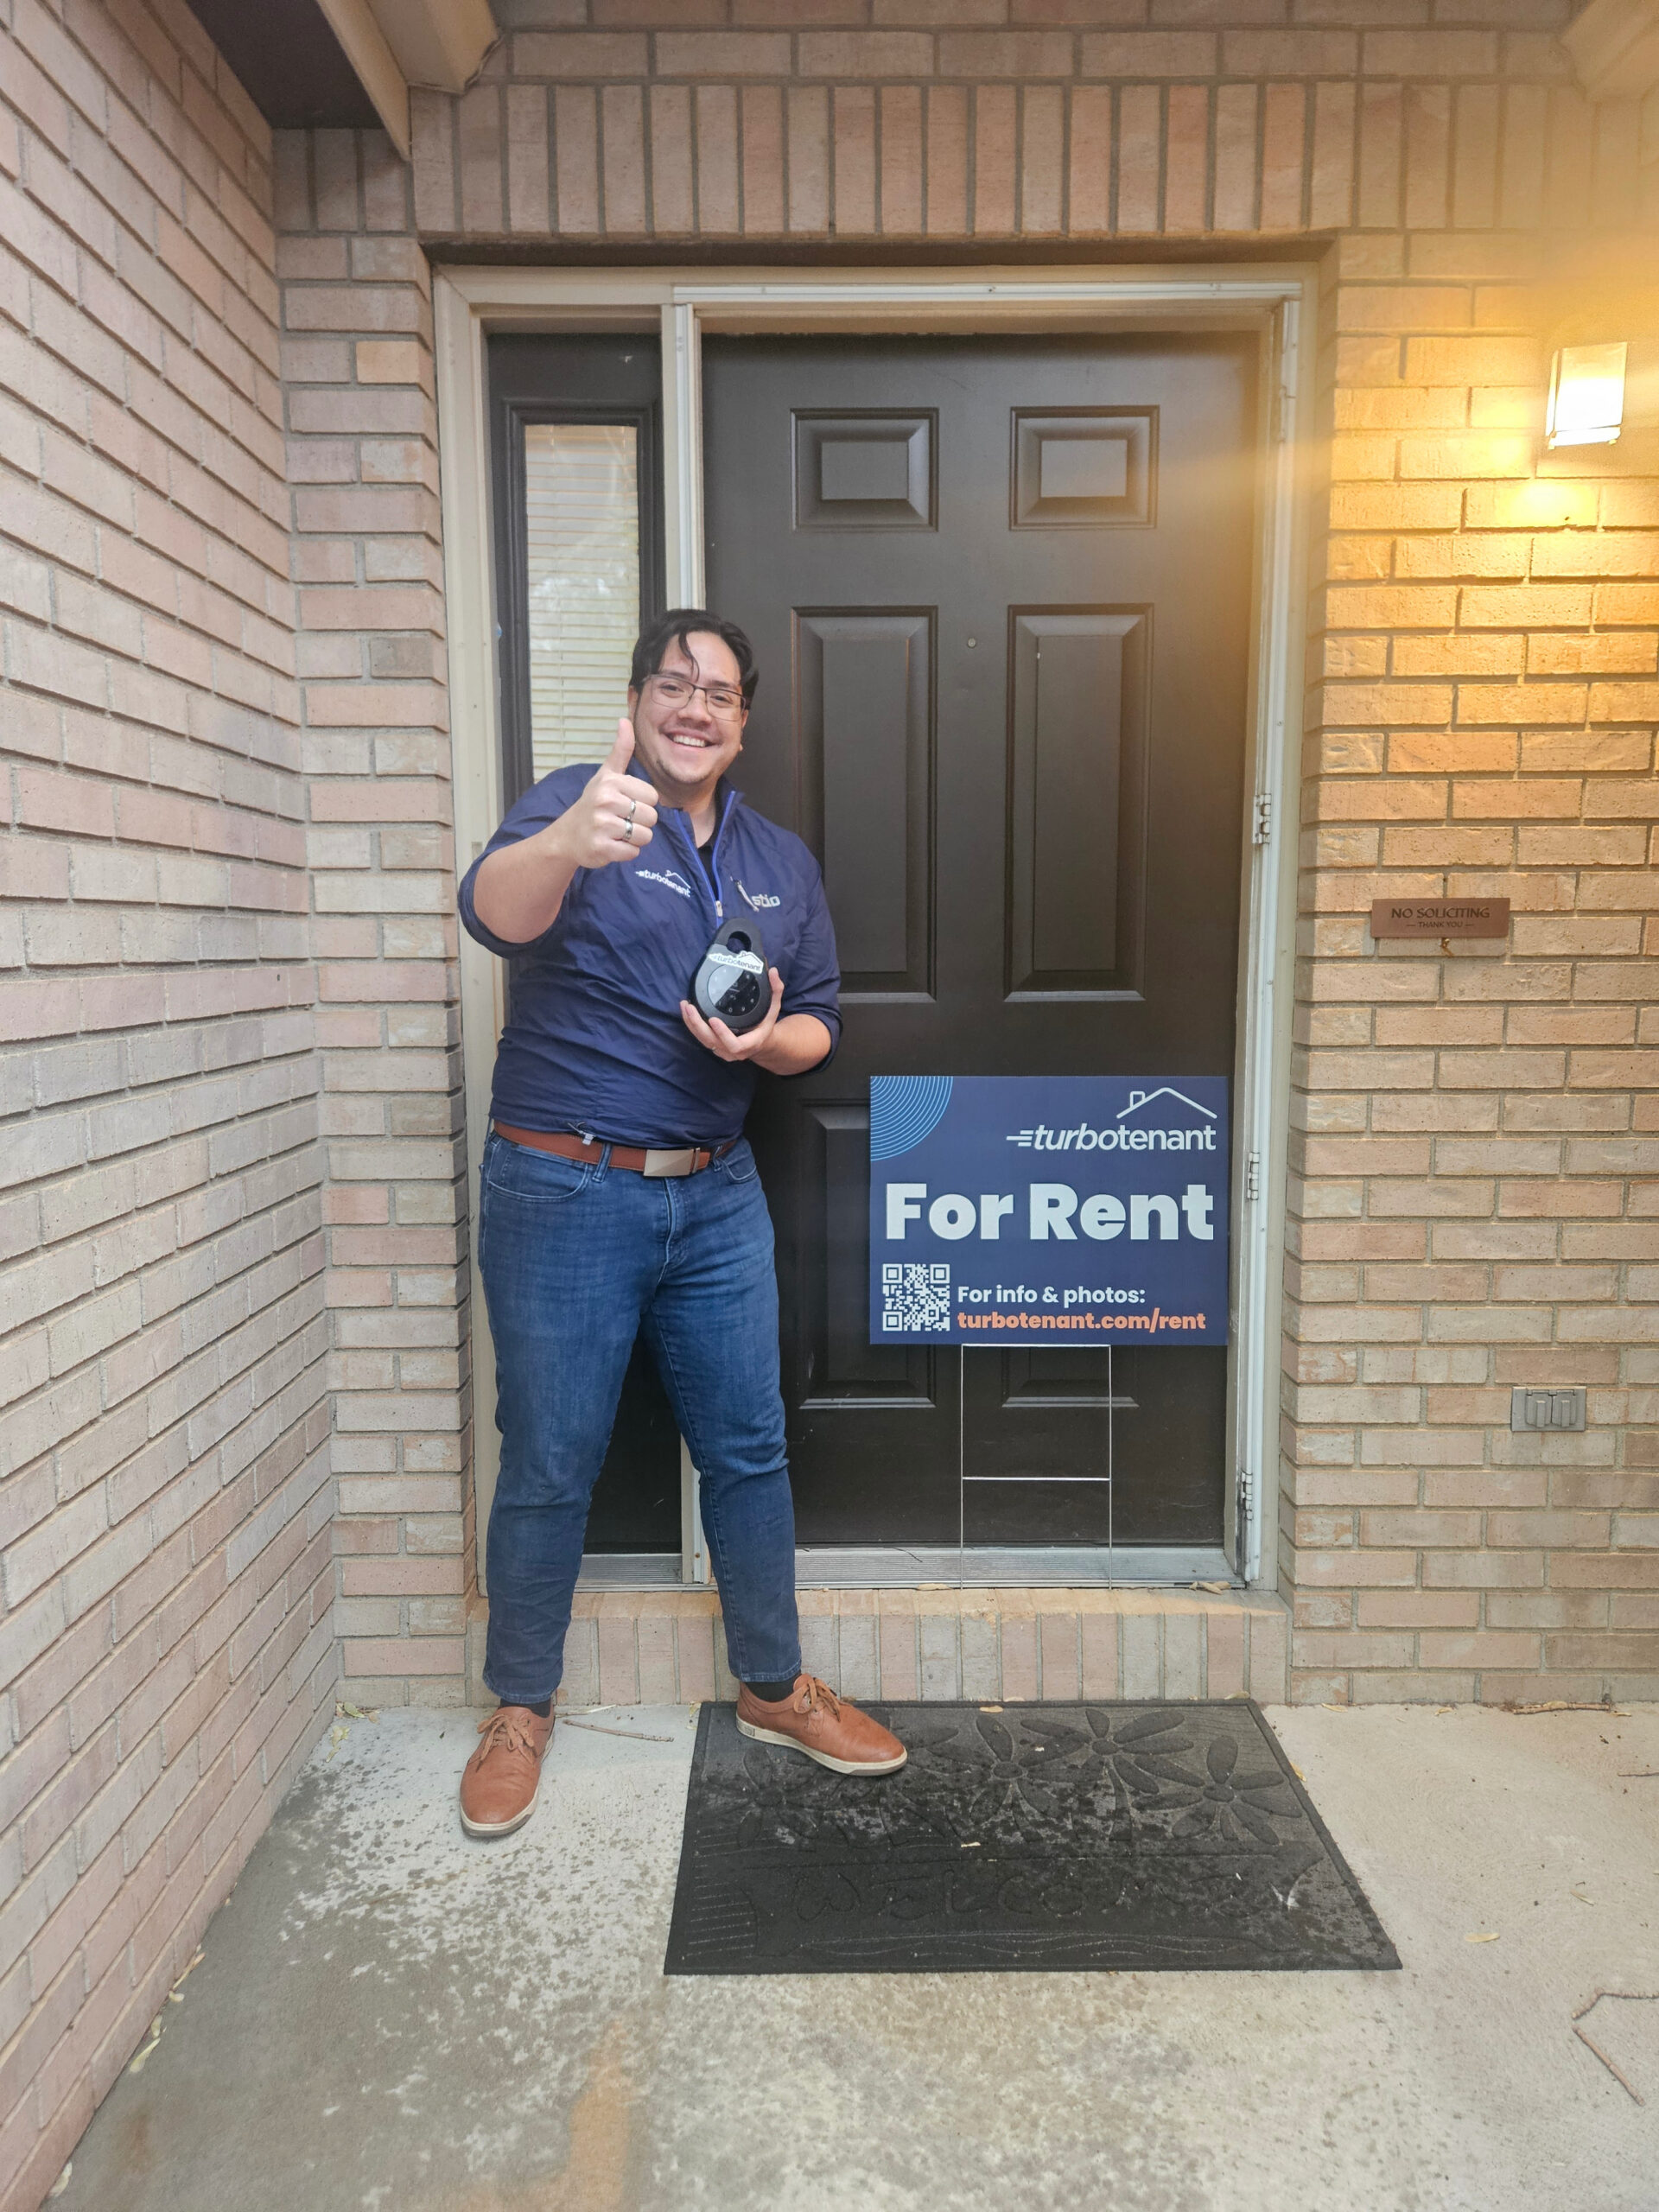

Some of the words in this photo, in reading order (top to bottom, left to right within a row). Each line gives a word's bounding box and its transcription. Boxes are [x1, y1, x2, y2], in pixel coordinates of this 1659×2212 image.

[1391, 907, 1414, 918] NO
[1416, 907, 1491, 918] SOLICITING
[1033, 1123, 1217, 1151] turbotenant
[886, 1183, 1014, 1242] For
[1029, 1183, 1214, 1241] Rent
[957, 1287, 992, 1303] For
[996, 1285, 1038, 1303] info
[1042, 1287, 1059, 1303] &
[1064, 1286, 1146, 1308] photos:
[957, 1308, 1206, 1333] turbotenant.com/rent
